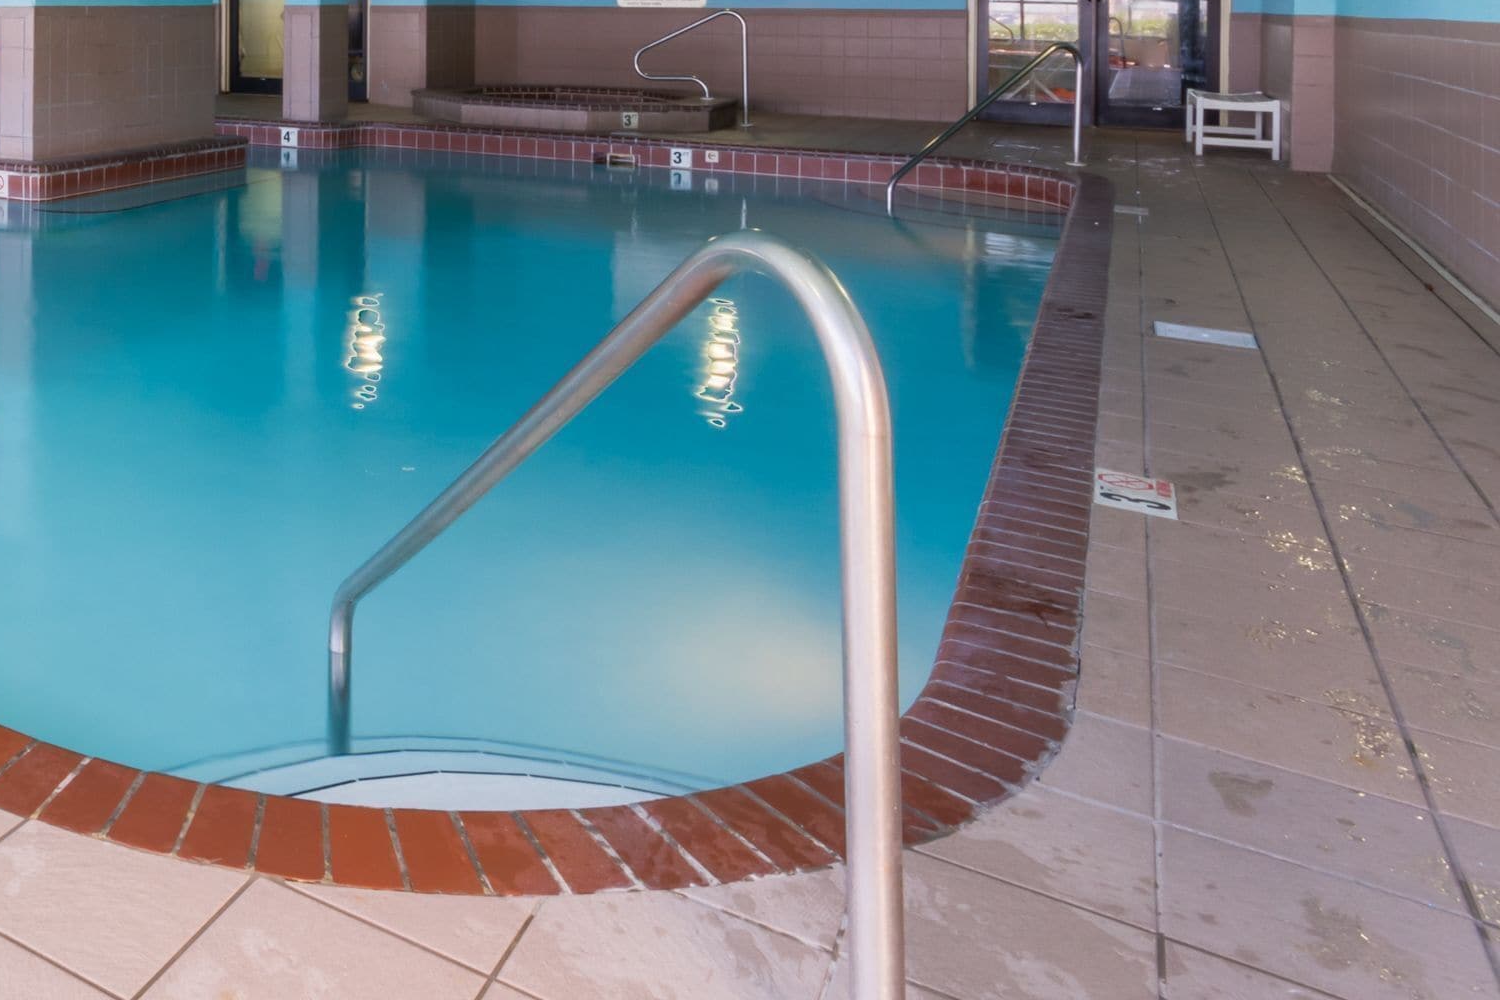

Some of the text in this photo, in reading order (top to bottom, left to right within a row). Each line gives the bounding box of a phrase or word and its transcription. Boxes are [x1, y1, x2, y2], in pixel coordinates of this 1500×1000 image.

[624, 114, 631, 126] 3
[284, 131, 290, 142] 4
[673, 152, 682, 164] 3
[1100, 492, 1171, 510] 3
